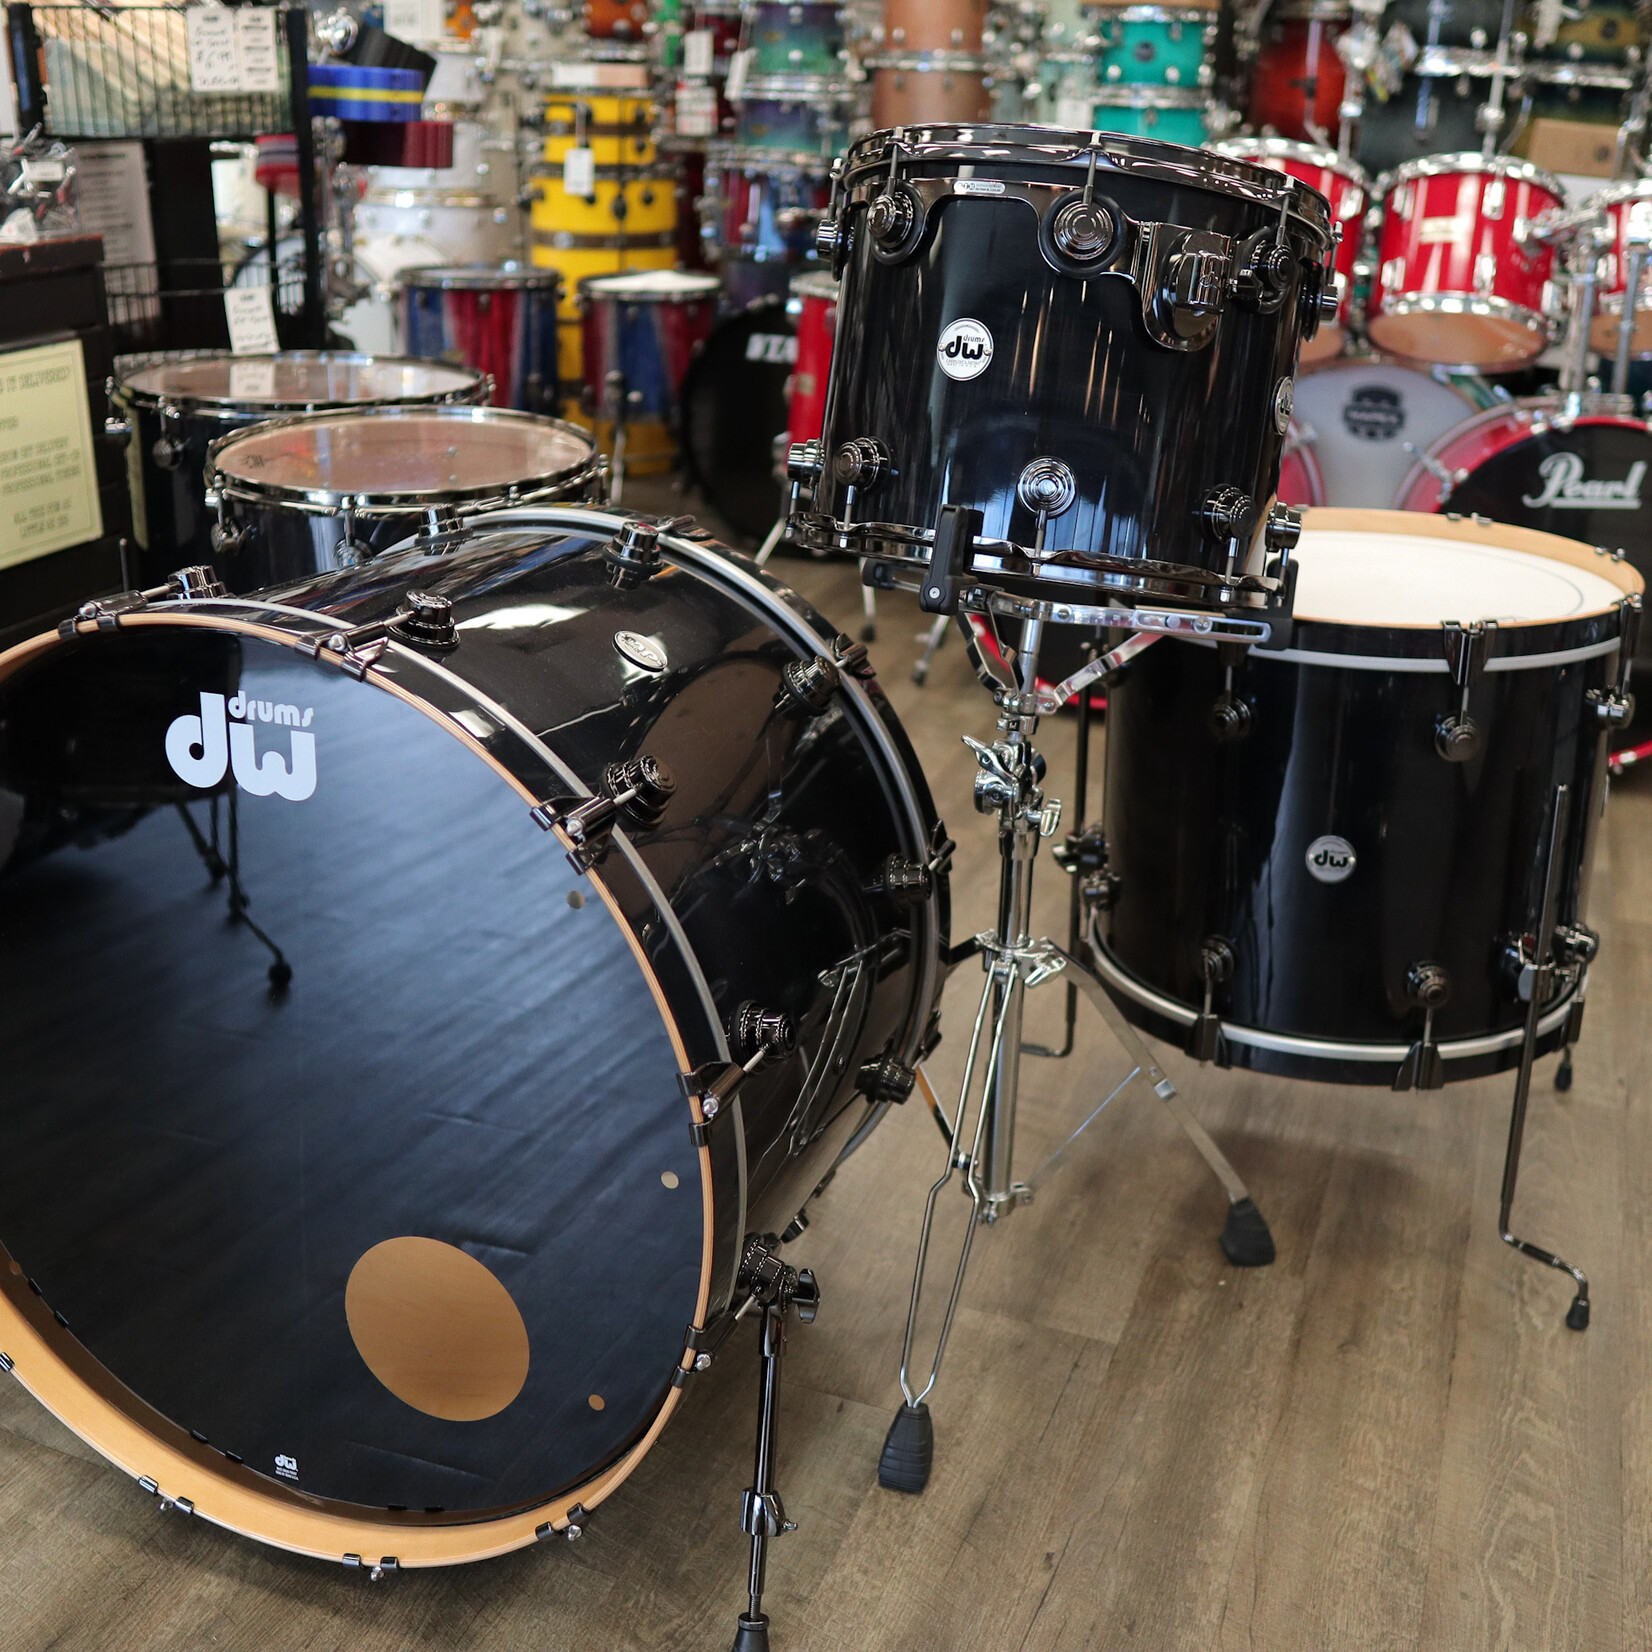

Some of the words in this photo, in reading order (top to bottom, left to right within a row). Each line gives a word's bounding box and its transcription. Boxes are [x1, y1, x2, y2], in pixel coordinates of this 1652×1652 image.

[945, 335, 984, 360] dw
[1522, 452, 1648, 508] Pearl
[228, 690, 314, 727] drums
[165, 691, 317, 801] dw
[1314, 849, 1348, 867] dw
